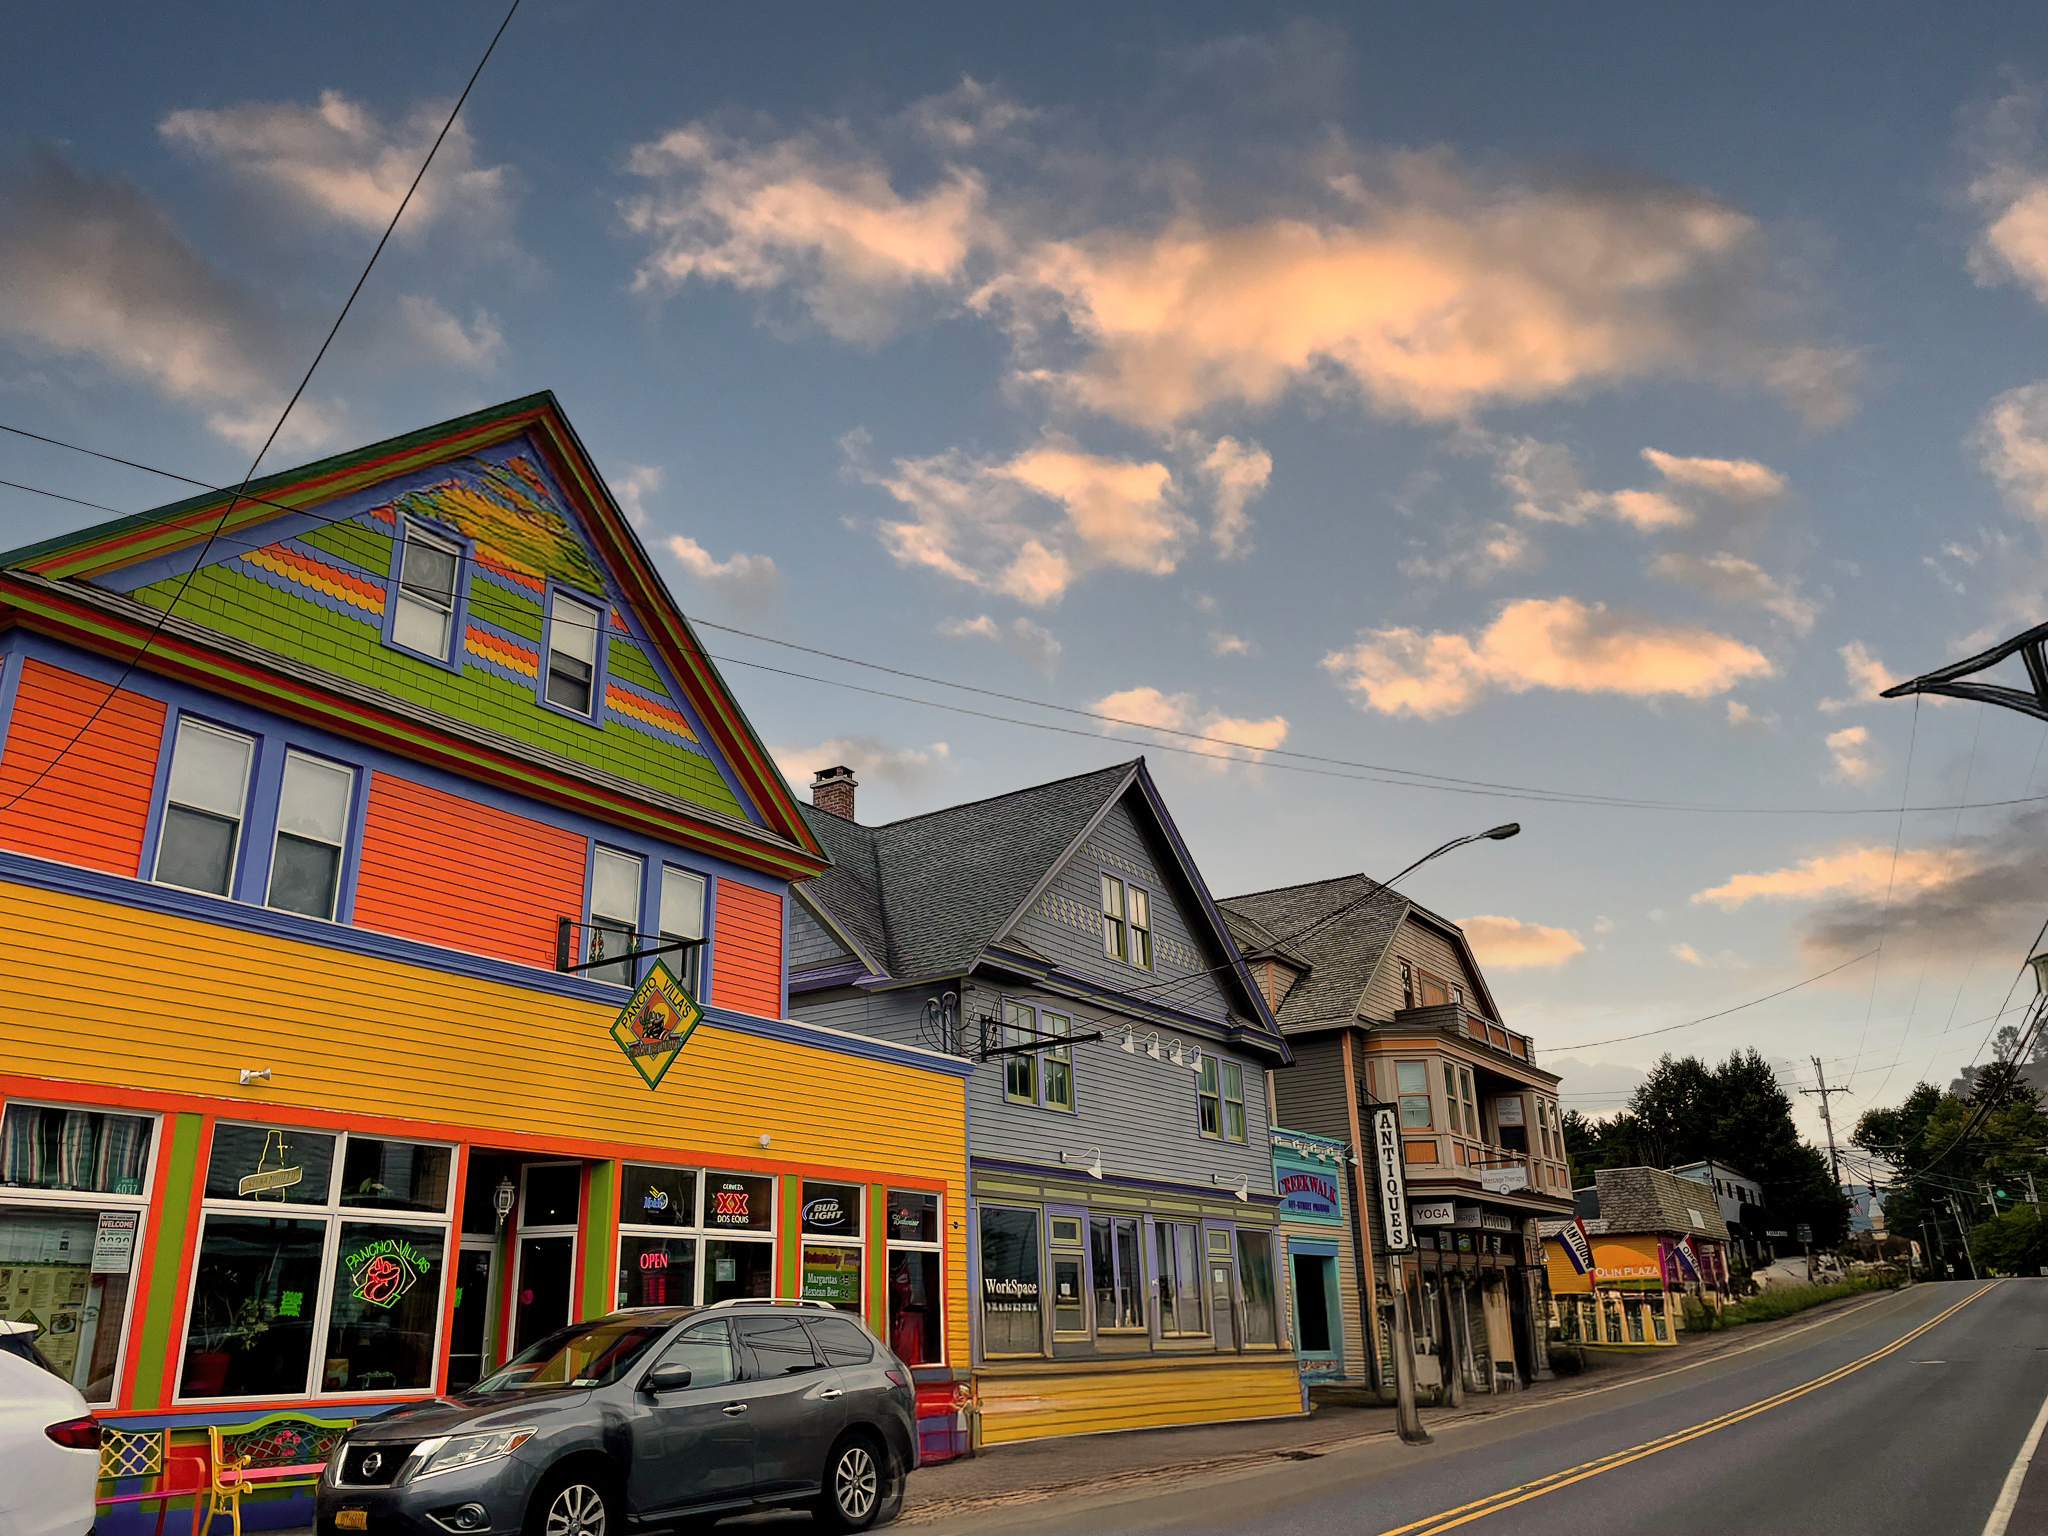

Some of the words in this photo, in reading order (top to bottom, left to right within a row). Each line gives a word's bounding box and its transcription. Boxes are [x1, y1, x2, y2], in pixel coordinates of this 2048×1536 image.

[621, 977, 657, 1029] PANCHO
[662, 979, 692, 1018] VILLA'S
[1380, 1113, 1403, 1245] ANTIQUES
[1278, 1174, 1337, 1205] CREEKWALK
[717, 1192, 749, 1215] XX
[814, 1203, 839, 1212] BUD
[717, 1215, 731, 1224] DOS
[731, 1215, 749, 1224] EQUIS
[808, 1210, 844, 1220] LIGHT
[1416, 1208, 1450, 1220] YOGA
[1456, 1212, 1479, 1223] ssage
[101, 1220, 134, 1228] WELCOME
[345, 1240, 392, 1271] PANCHO
[640, 1253, 668, 1269] OPEN
[1595, 1267, 1622, 1278] OLIN
[1624, 1266, 1659, 1276] PLAZA
[807, 1272, 838, 1287] Margaritas
[826, 1286, 839, 1297] Beer
[985, 1279, 1038, 1299] WorkSpace
